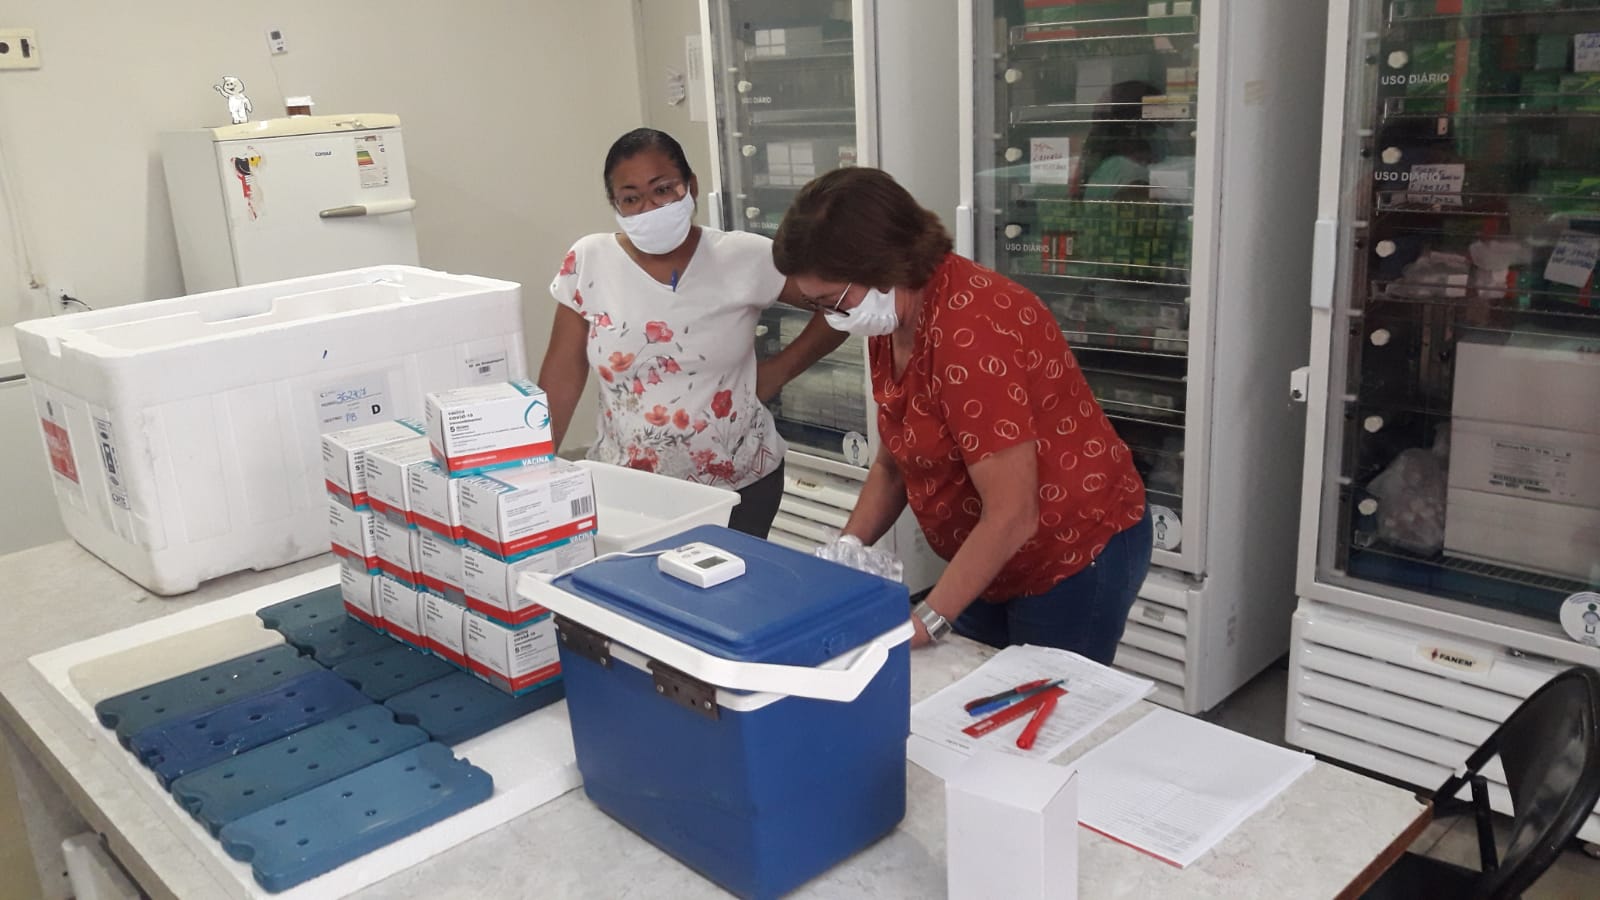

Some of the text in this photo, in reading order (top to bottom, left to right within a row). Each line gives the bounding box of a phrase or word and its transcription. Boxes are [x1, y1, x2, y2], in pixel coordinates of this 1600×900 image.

[1381, 71, 1450, 85] USO DIÁRIO
[1374, 171, 1398, 181] USO
[1005, 242, 1049, 253] USO DIÁRIO
[371, 404, 381, 415] D
[522, 456, 550, 466] VACINA
[570, 531, 594, 543] VACINA
[1440, 653, 1473, 666] FANEM
